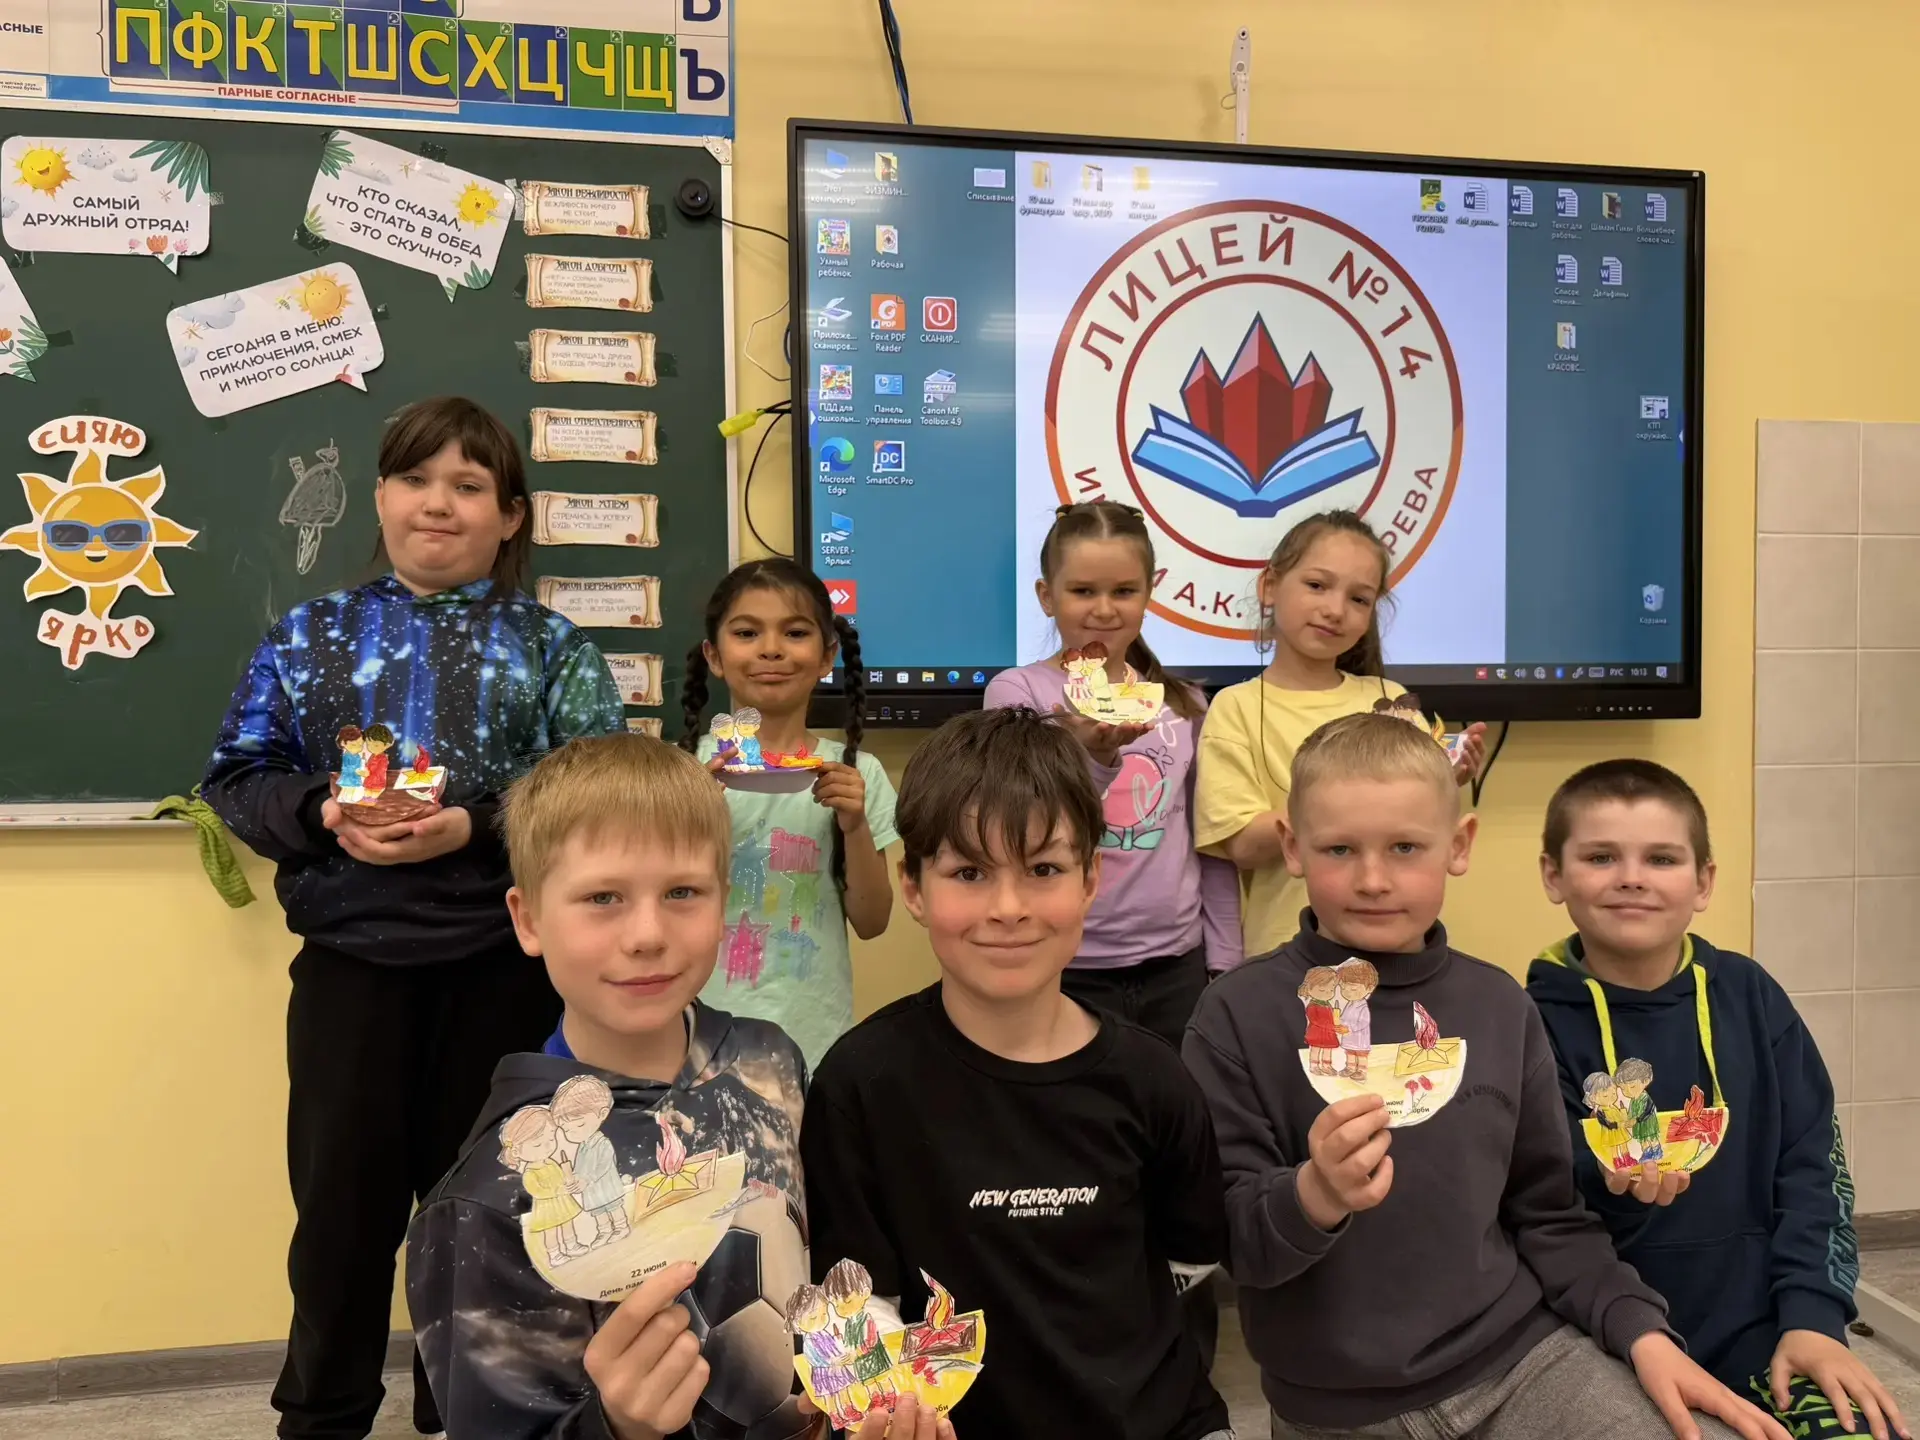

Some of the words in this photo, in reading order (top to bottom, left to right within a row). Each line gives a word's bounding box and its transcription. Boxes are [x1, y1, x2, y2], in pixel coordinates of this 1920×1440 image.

[115, 7, 162, 66] П
[172, 11, 224, 69] Ф
[347, 22, 398, 82] Ш
[518, 37, 564, 103] Ц
[576, 41, 616, 97] Ч
[625, 44, 674, 109] Щ
[217, 86, 274, 99] ПАРНЫЕ
[276, 90, 357, 104] СОГЛАСНЫЕ
[73, 195, 140, 211] САМЫЙ
[967, 191, 1016, 203] Списывание
[357, 185, 390, 205] КТО
[395, 198, 463, 233] СКАЗАЛ,
[22, 213, 118, 229] ДРУЖНЫЙ
[124, 217, 189, 233] ОТРЯД!
[326, 192, 359, 213] ЧТО
[363, 206, 416, 234] СПАТЬ
[420, 225, 433, 240] В
[437, 230, 483, 258] ОБЕД
[349, 220, 383, 242] ЭТО
[387, 233, 463, 268] СКУЧНО?
[820, 257, 849, 267] Умный
[871, 260, 904, 270] Рабочая
[1079, 214, 1295, 372] ЛИЦЕЙ
[206, 334, 277, 362] СЕГОДНЯ
[281, 330, 292, 342] В
[294, 315, 346, 337] МЕНЮ:
[870, 332, 890, 341] Foxit
[890, 333, 906, 342] PDF
[199, 341, 320, 382] ПРИКЛЮЧЕНИЯ,
[321, 327, 364, 347] СМЕХ
[875, 344, 902, 353] Reader
[218, 381, 231, 393] И
[234, 366, 287, 389] МНОГО
[290, 346, 355, 373] СОЛНЦА!
[874, 405, 904, 414] Панель
[921, 406, 946, 415] Canon
[947, 406, 960, 415] MF
[865, 416, 912, 425] управления
[920, 417, 950, 426] Toolbox
[951, 417, 963, 426] 4.9
[880, 452, 900, 464] DC
[819, 475, 856, 485] Microsoft
[866, 476, 899, 485] SmartDC
[900, 476, 914, 486] Pro
[827, 486, 847, 496] Edge
[821, 546, 849, 555] SERVER
[824, 557, 851, 567] Ярлык
[1609, 667, 1624, 677] РУС
[969, 1189, 1009, 1209] NEW
[1009, 1185, 1099, 1208] GENERATION
[1008, 1207, 1039, 1218] FUTURE
[1040, 1206, 1065, 1216] STYLE
[631, 1268, 642, 1278] 22
[643, 1260, 667, 1275] июня
[600, 1287, 624, 1298] День
